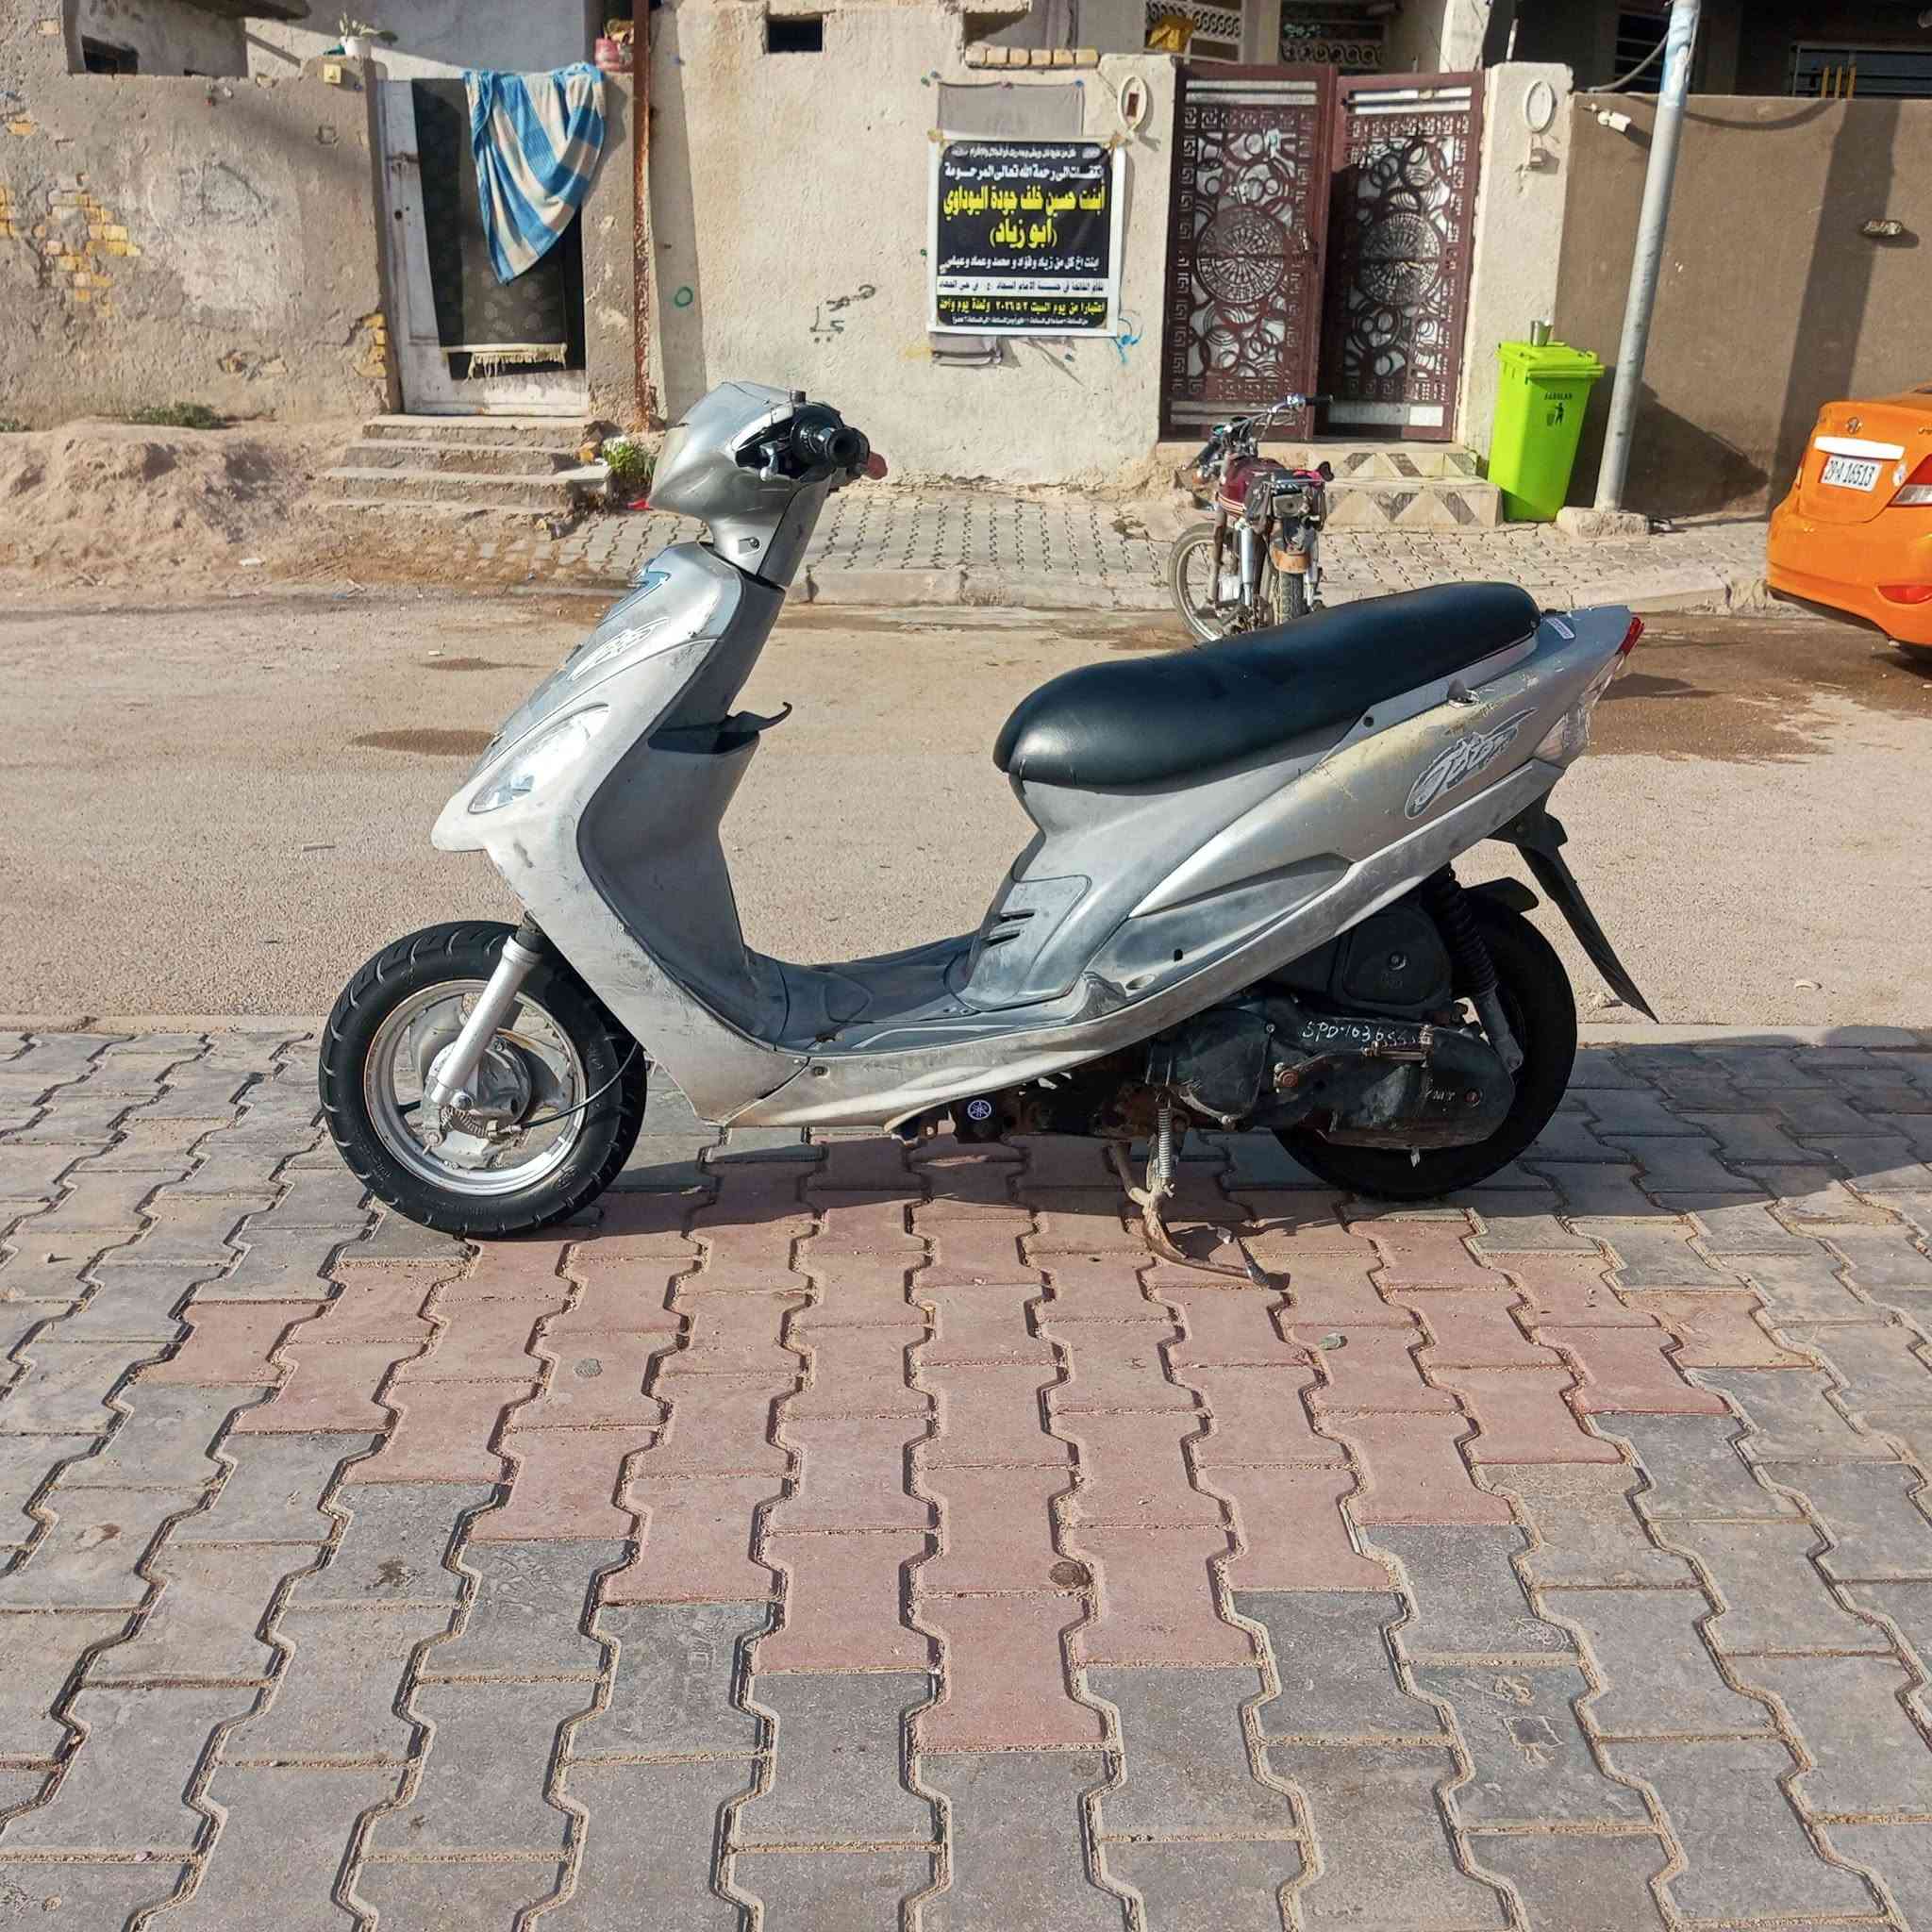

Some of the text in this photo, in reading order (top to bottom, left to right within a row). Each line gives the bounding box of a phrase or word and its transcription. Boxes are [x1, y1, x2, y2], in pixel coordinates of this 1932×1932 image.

[993, 164, 1020, 181] تعالى
[1020, 163, 1033, 178] الله
[1033, 163, 1056, 181] رحمة
[991, 186, 1018, 216] جودة
[1020, 185, 1044, 210] خلف
[1045, 190, 1076, 217] حسين
[1053, 302, 1068, 316] يوم
